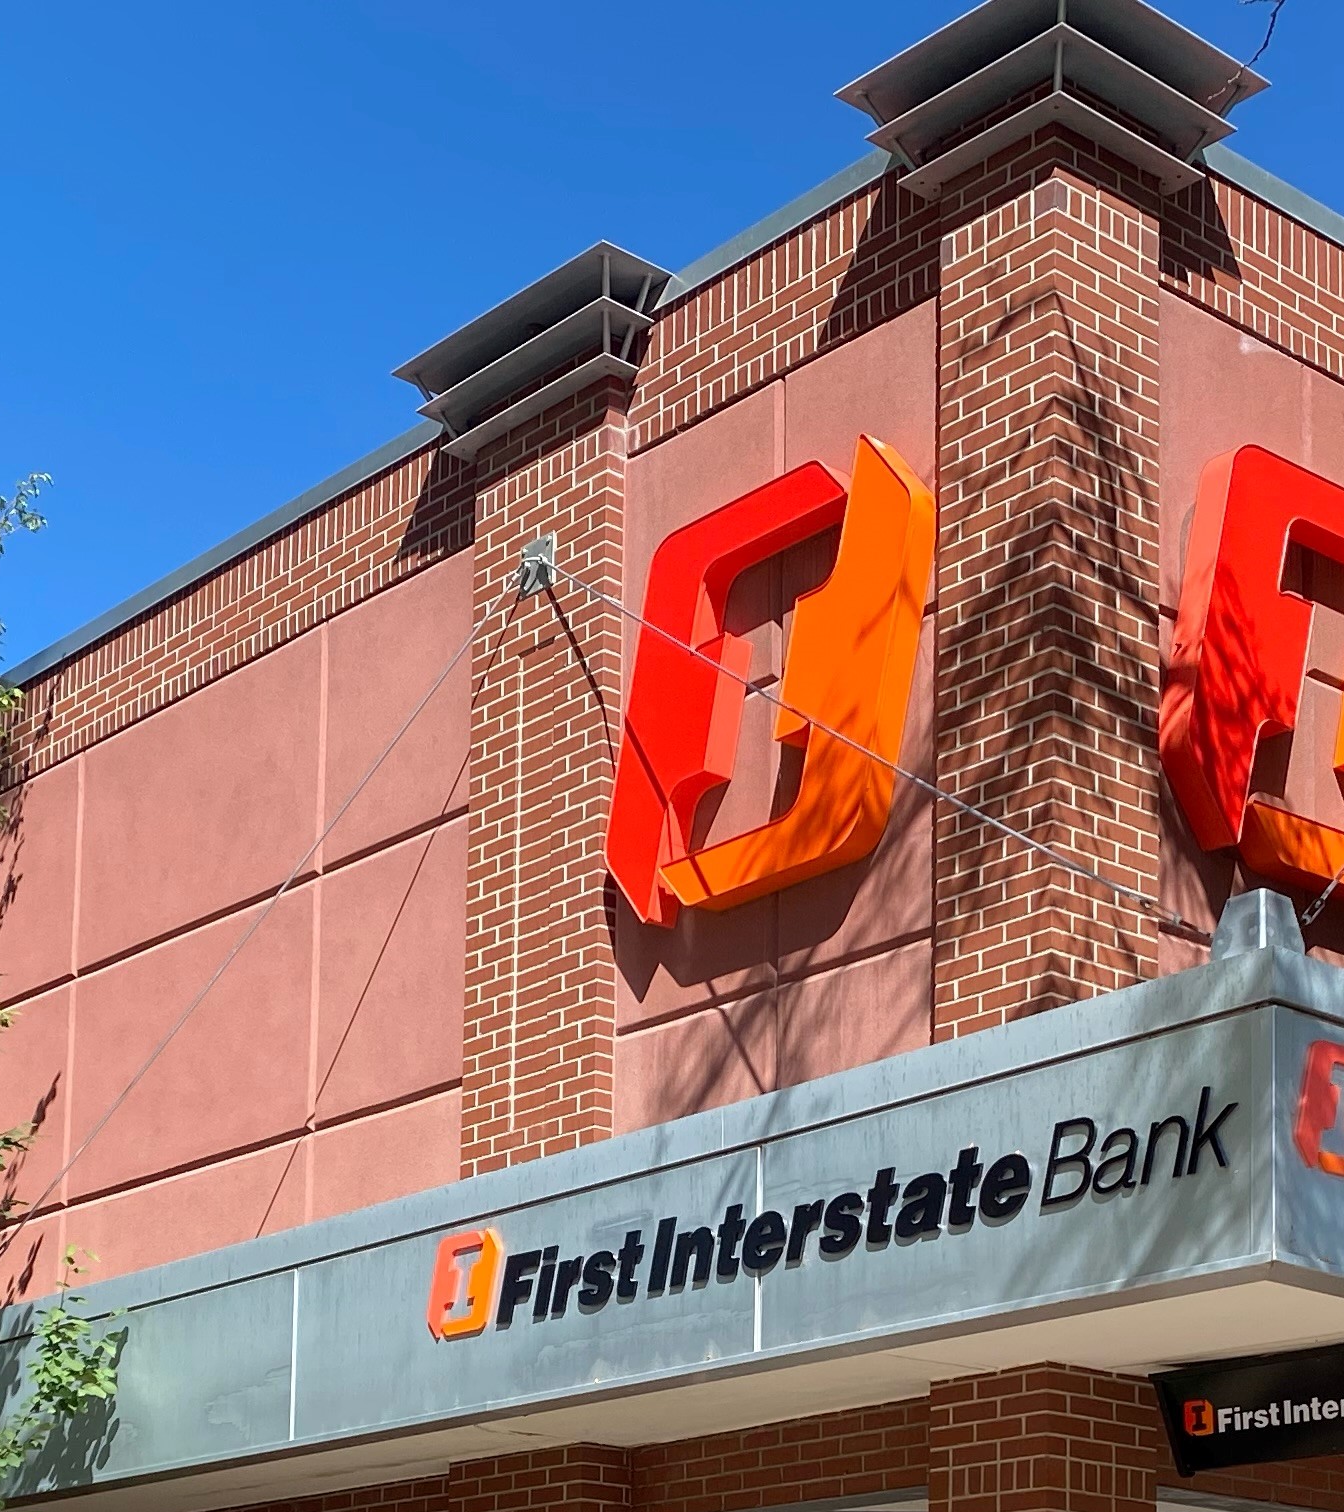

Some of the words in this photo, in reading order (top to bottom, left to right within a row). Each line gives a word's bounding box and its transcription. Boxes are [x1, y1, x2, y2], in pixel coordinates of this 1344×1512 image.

[496, 1228, 642, 1326] First
[647, 1145, 1031, 1297] Interstate
[1040, 1086, 1240, 1208] Bank
[1217, 1404, 1280, 1434] First
